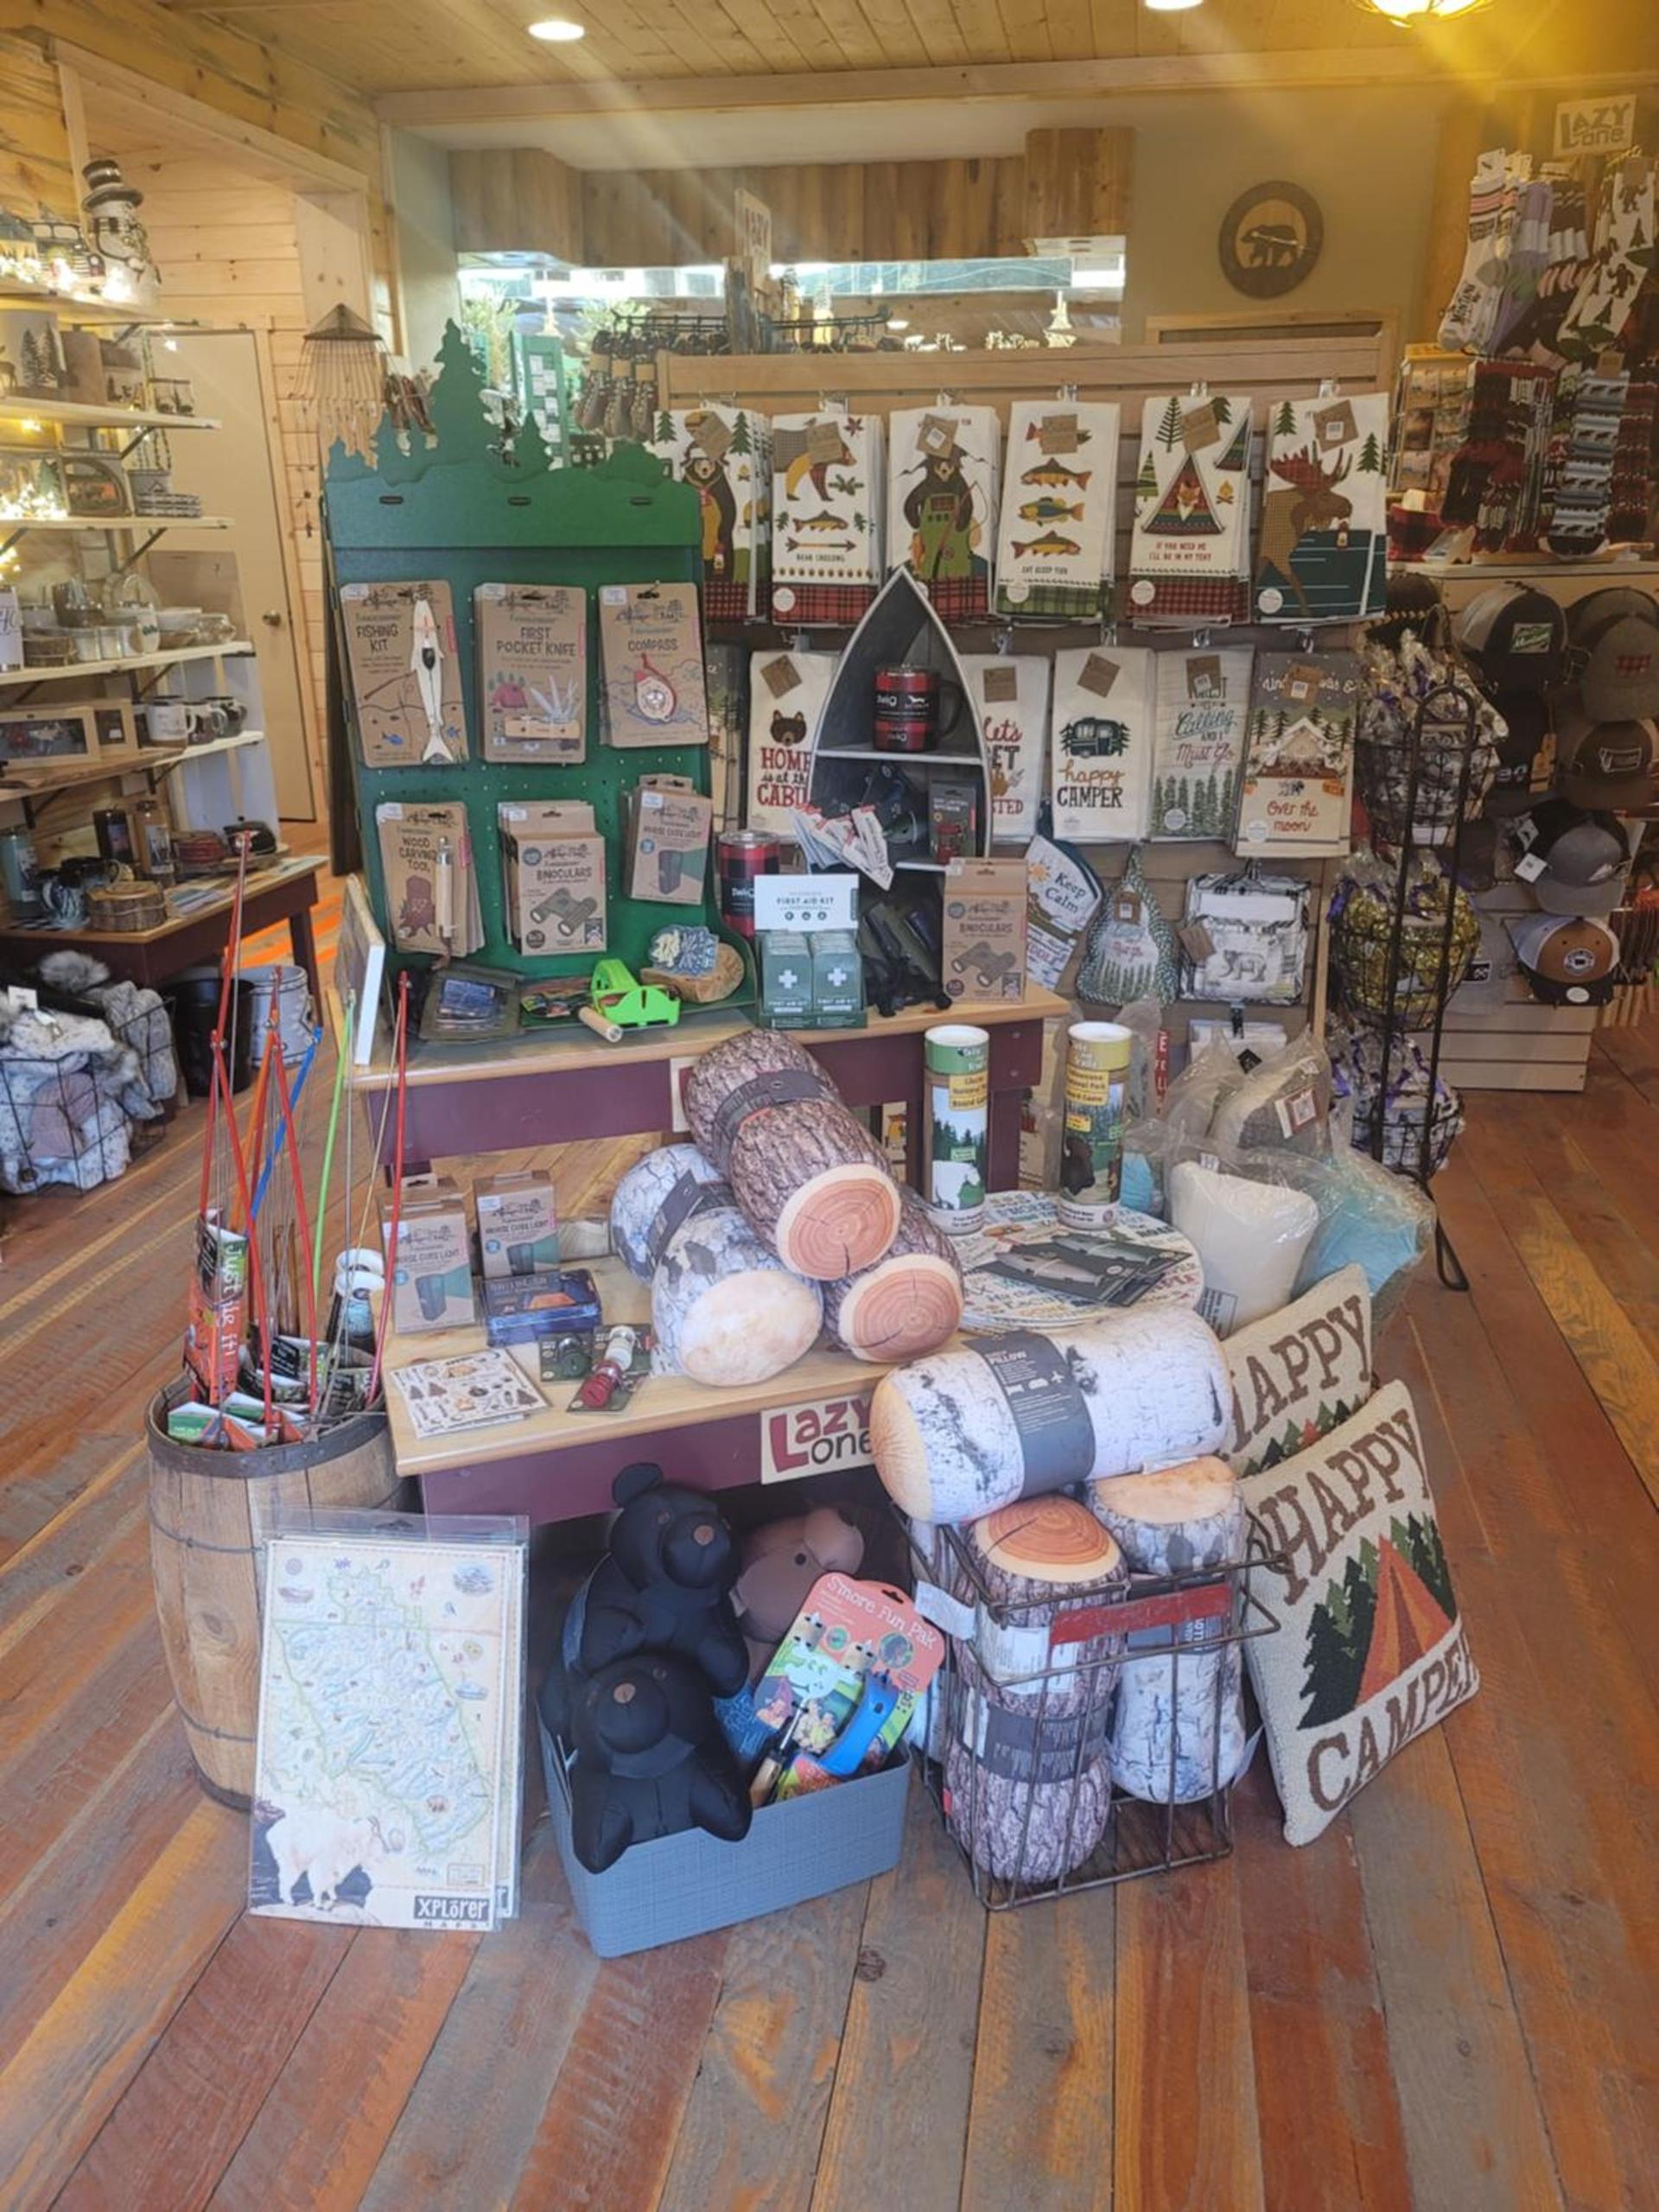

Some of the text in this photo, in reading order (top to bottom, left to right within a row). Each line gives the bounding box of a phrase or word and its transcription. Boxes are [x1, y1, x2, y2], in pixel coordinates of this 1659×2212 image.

[356, 624, 399, 639] FISHING
[520, 626, 551, 639] FIRST
[369, 639, 388, 654] KIT
[496, 639, 577, 657] POCKET KNIFE
[627, 638, 679, 652] COMPASS
[760, 747, 811, 772] HOME
[1058, 758, 1127, 788] happy
[1056, 785, 1123, 809] CAMPER
[402, 836, 430, 849] WOOD
[407, 860, 430, 873] TOOL
[536, 867, 593, 881] BINOCULARS
[1054, 872, 1086, 899] Keep
[1045, 887, 1079, 915] Calm
[223, 1246, 243, 1294] Just
[810, 1430, 873, 1465] one
[1259, 1408, 1430, 1605] HAPPY
[878, 1605, 906, 1630] Fun
[907, 1621, 937, 1650] Pak
